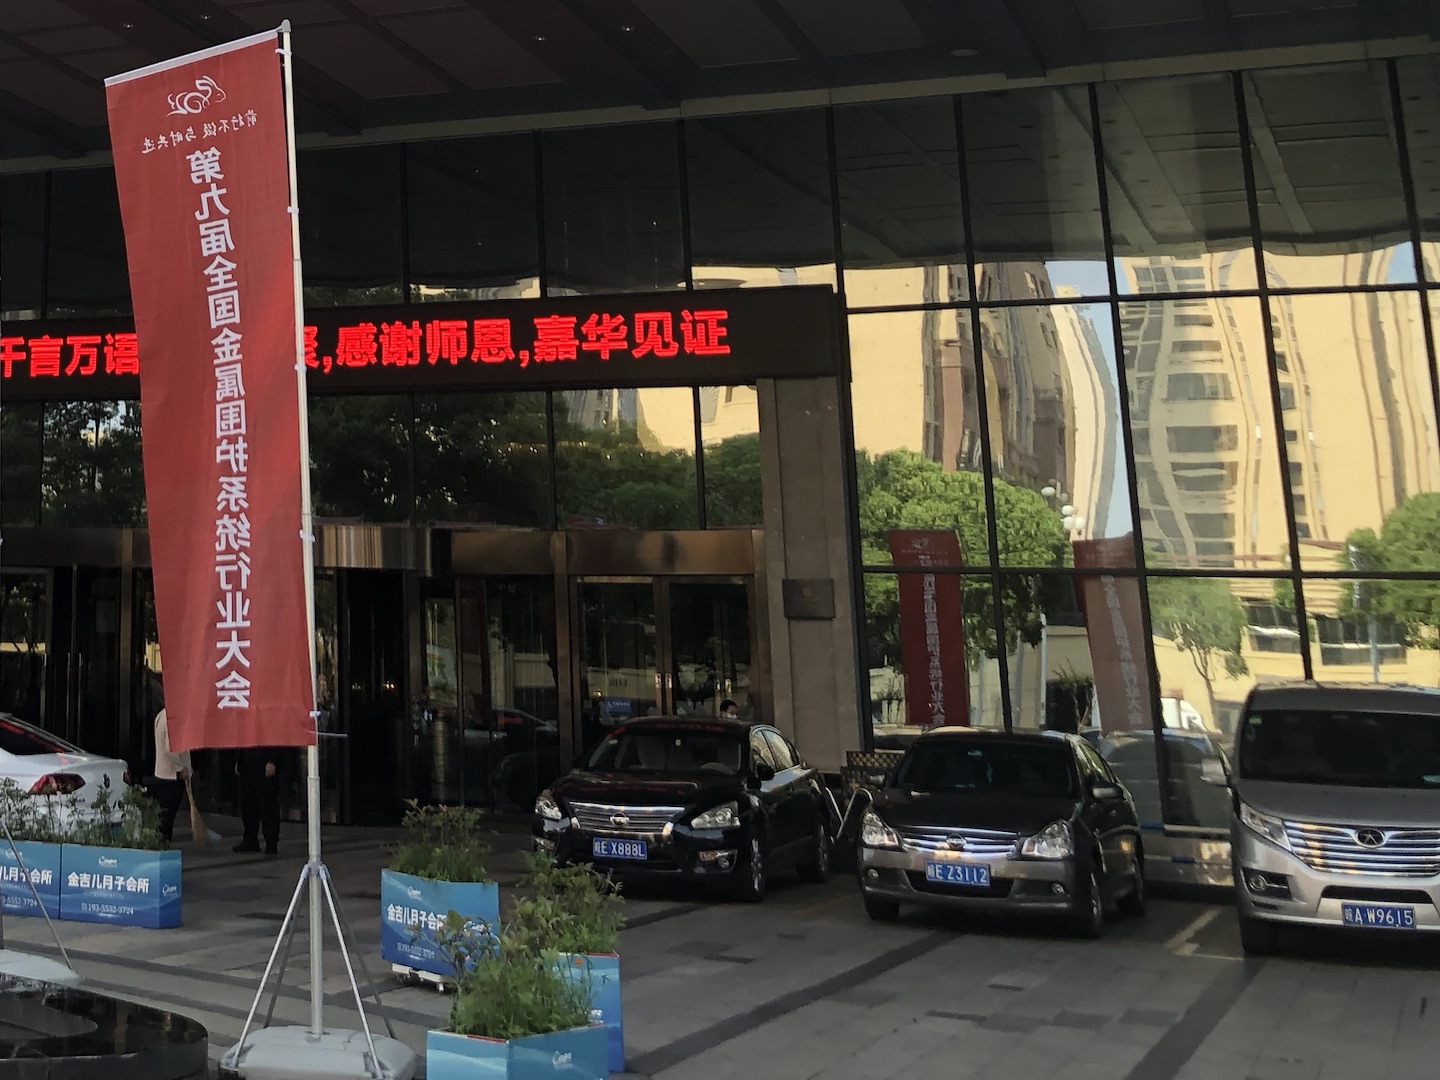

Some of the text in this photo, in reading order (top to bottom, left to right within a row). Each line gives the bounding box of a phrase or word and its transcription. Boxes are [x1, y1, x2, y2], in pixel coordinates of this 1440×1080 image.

[67, 871, 150, 894] 金吉儿月子会所
